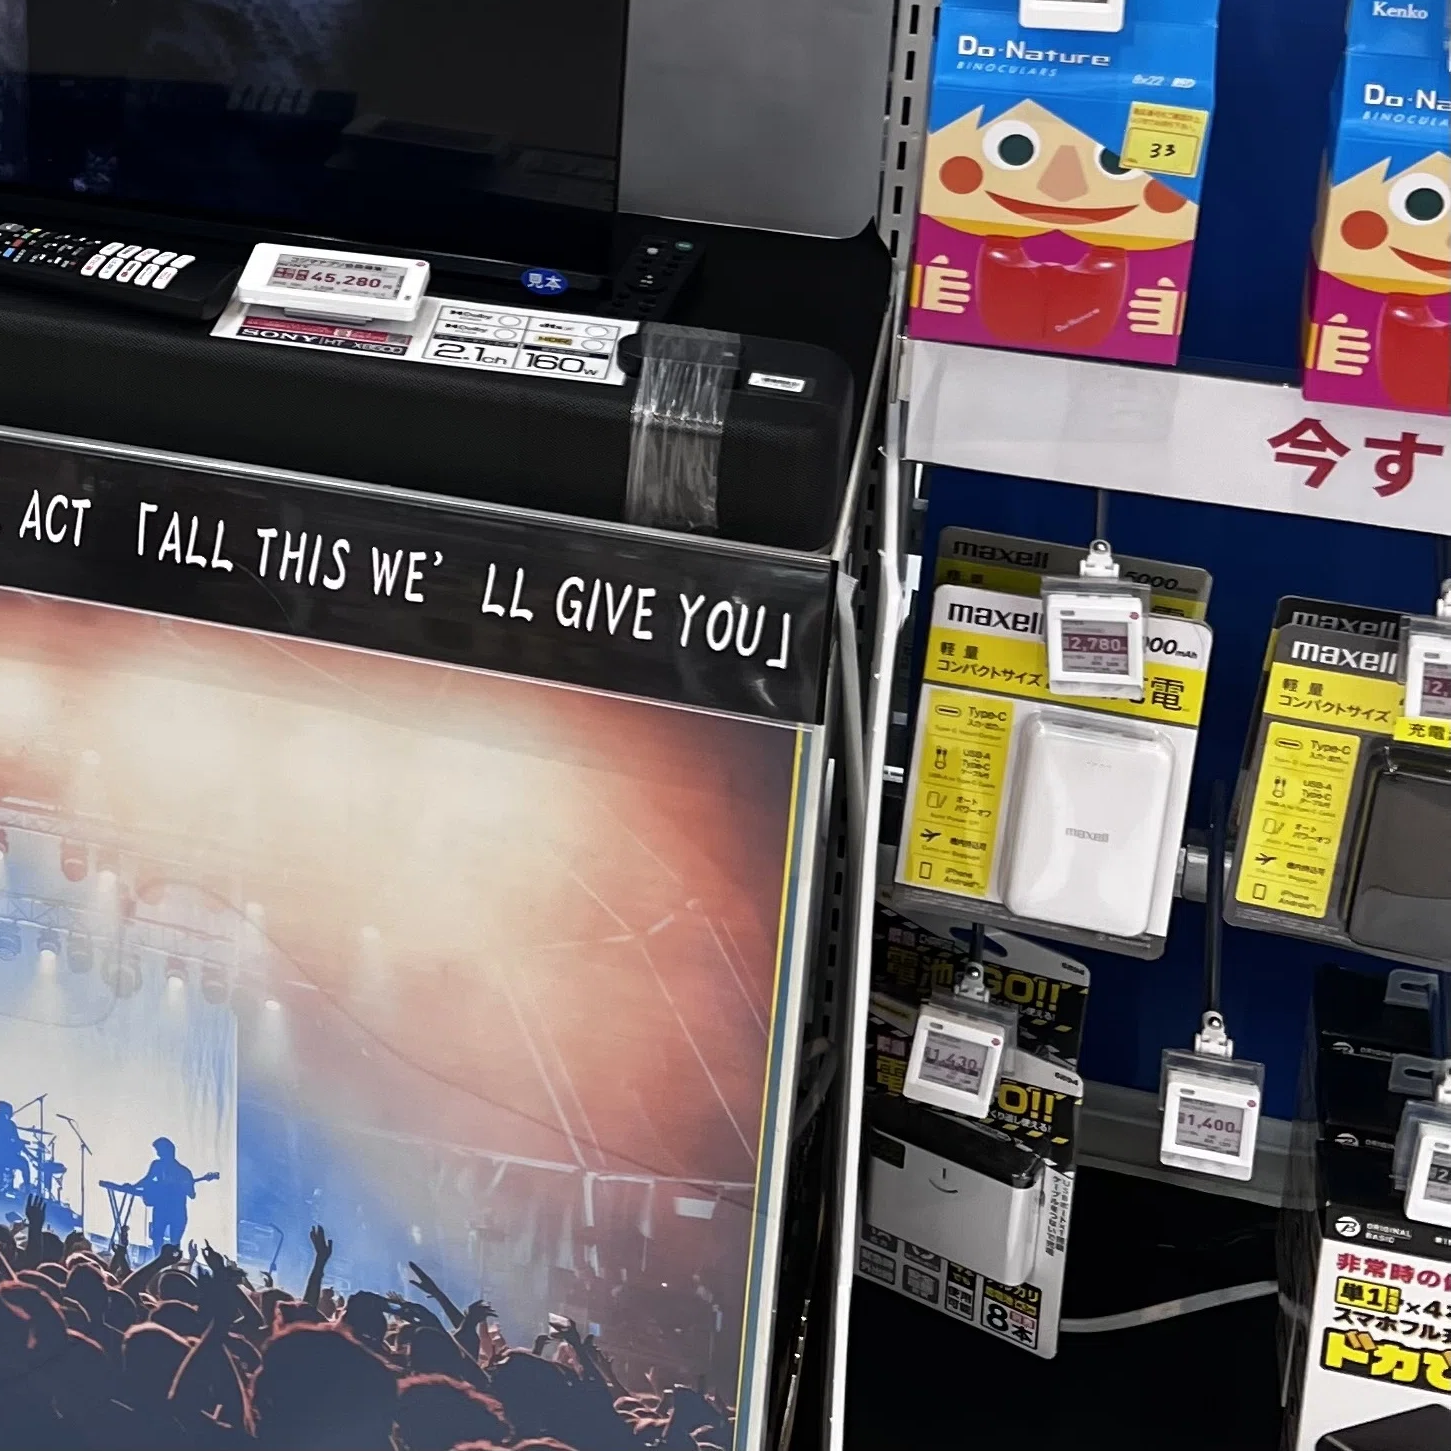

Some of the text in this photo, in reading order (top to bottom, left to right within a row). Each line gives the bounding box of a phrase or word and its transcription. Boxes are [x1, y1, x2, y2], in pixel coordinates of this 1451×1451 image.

[1372, 1, 1429, 19] Kenko
[956, 61, 1058, 77] BINOCULARS
[311, 271, 381, 289] 45,280
[526, 272, 562, 290] 見本
[238, 327, 318, 344] SONY
[433, 342, 507, 365] 2.1ch
[1266, 416, 1445, 498] 今す
[952, 539, 1050, 569] maxell
[19, 490, 93, 547] ACT
[256, 526, 351, 591] THIS
[554, 575, 657, 641] GIVE
[948, 603, 1045, 635] maxell
[1070, 636, 1121, 652] 2,780
[1291, 640, 1398, 675] maxell
[937, 659, 1043, 687] コンパクトサイズ
[968, 706, 1008, 722] Type-C
[1278, 694, 1392, 723] コンパクトサイズ
[1407, 723, 1451, 742] 充電
[1310, 739, 1351, 756] Type-C
[1065, 827, 1110, 843] maxell
[1365, 1232, 1396, 1244] BASIC
[1366, 1222, 1413, 1238] ORIGINAL
